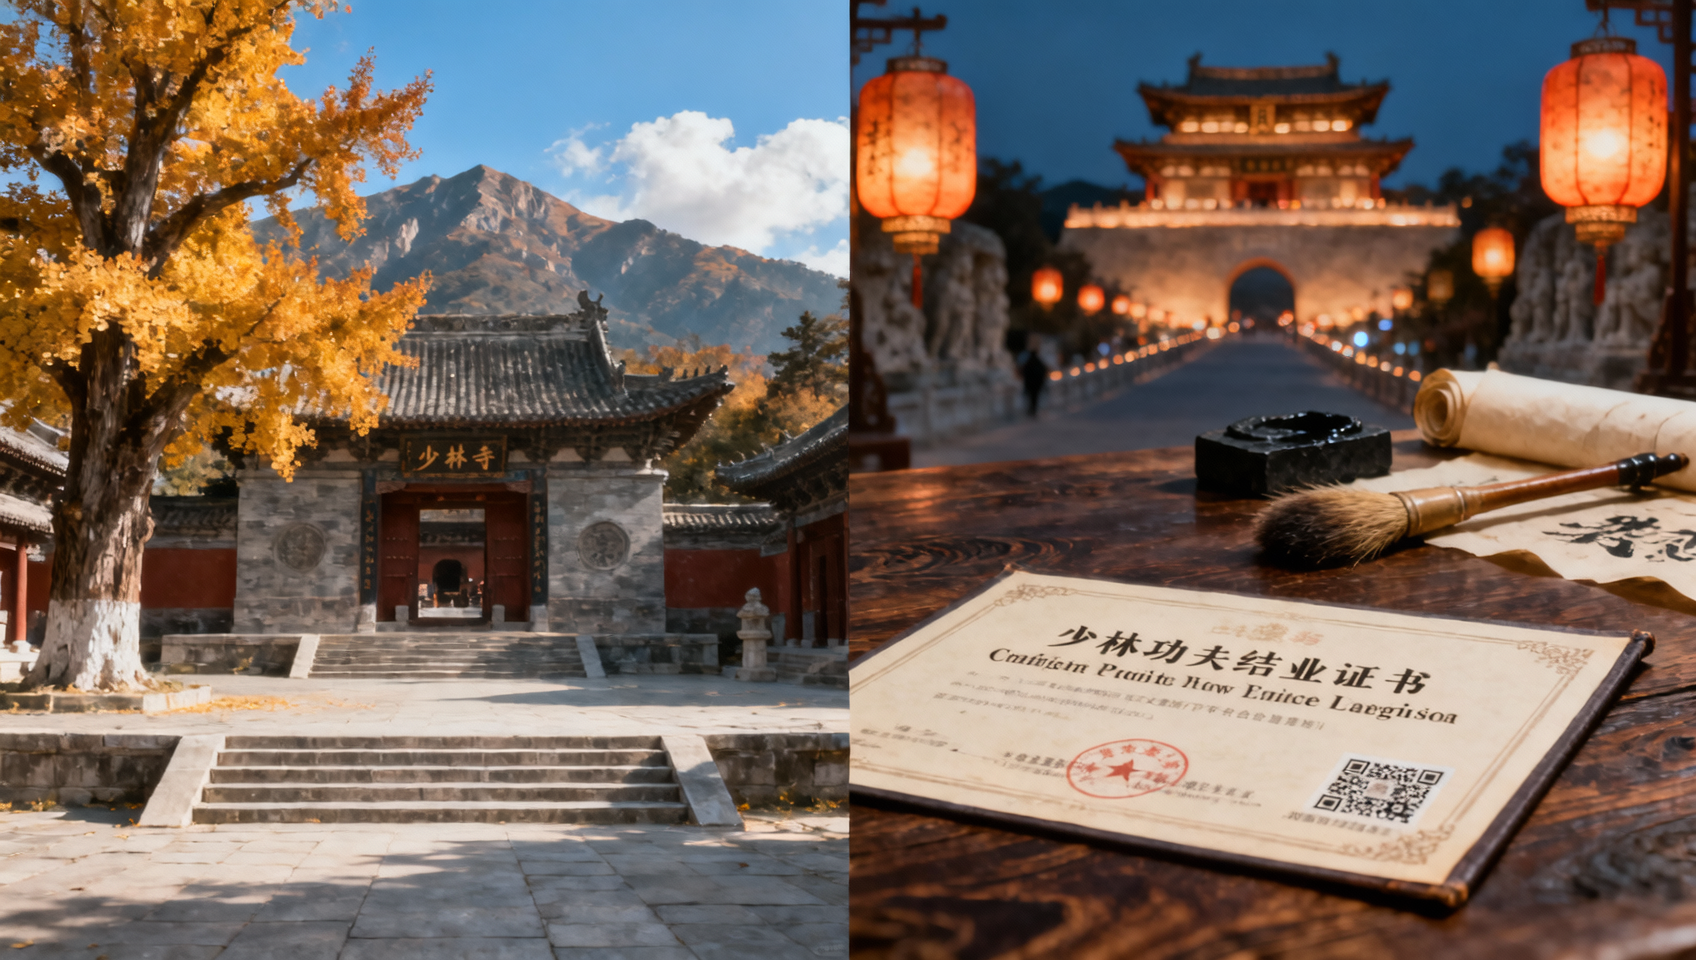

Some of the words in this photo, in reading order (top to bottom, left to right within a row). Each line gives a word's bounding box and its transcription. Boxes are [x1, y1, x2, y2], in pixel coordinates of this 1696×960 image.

[413, 444, 495, 471] 少林寺
[1047, 625, 1431, 694] 少林功夫结业证书
